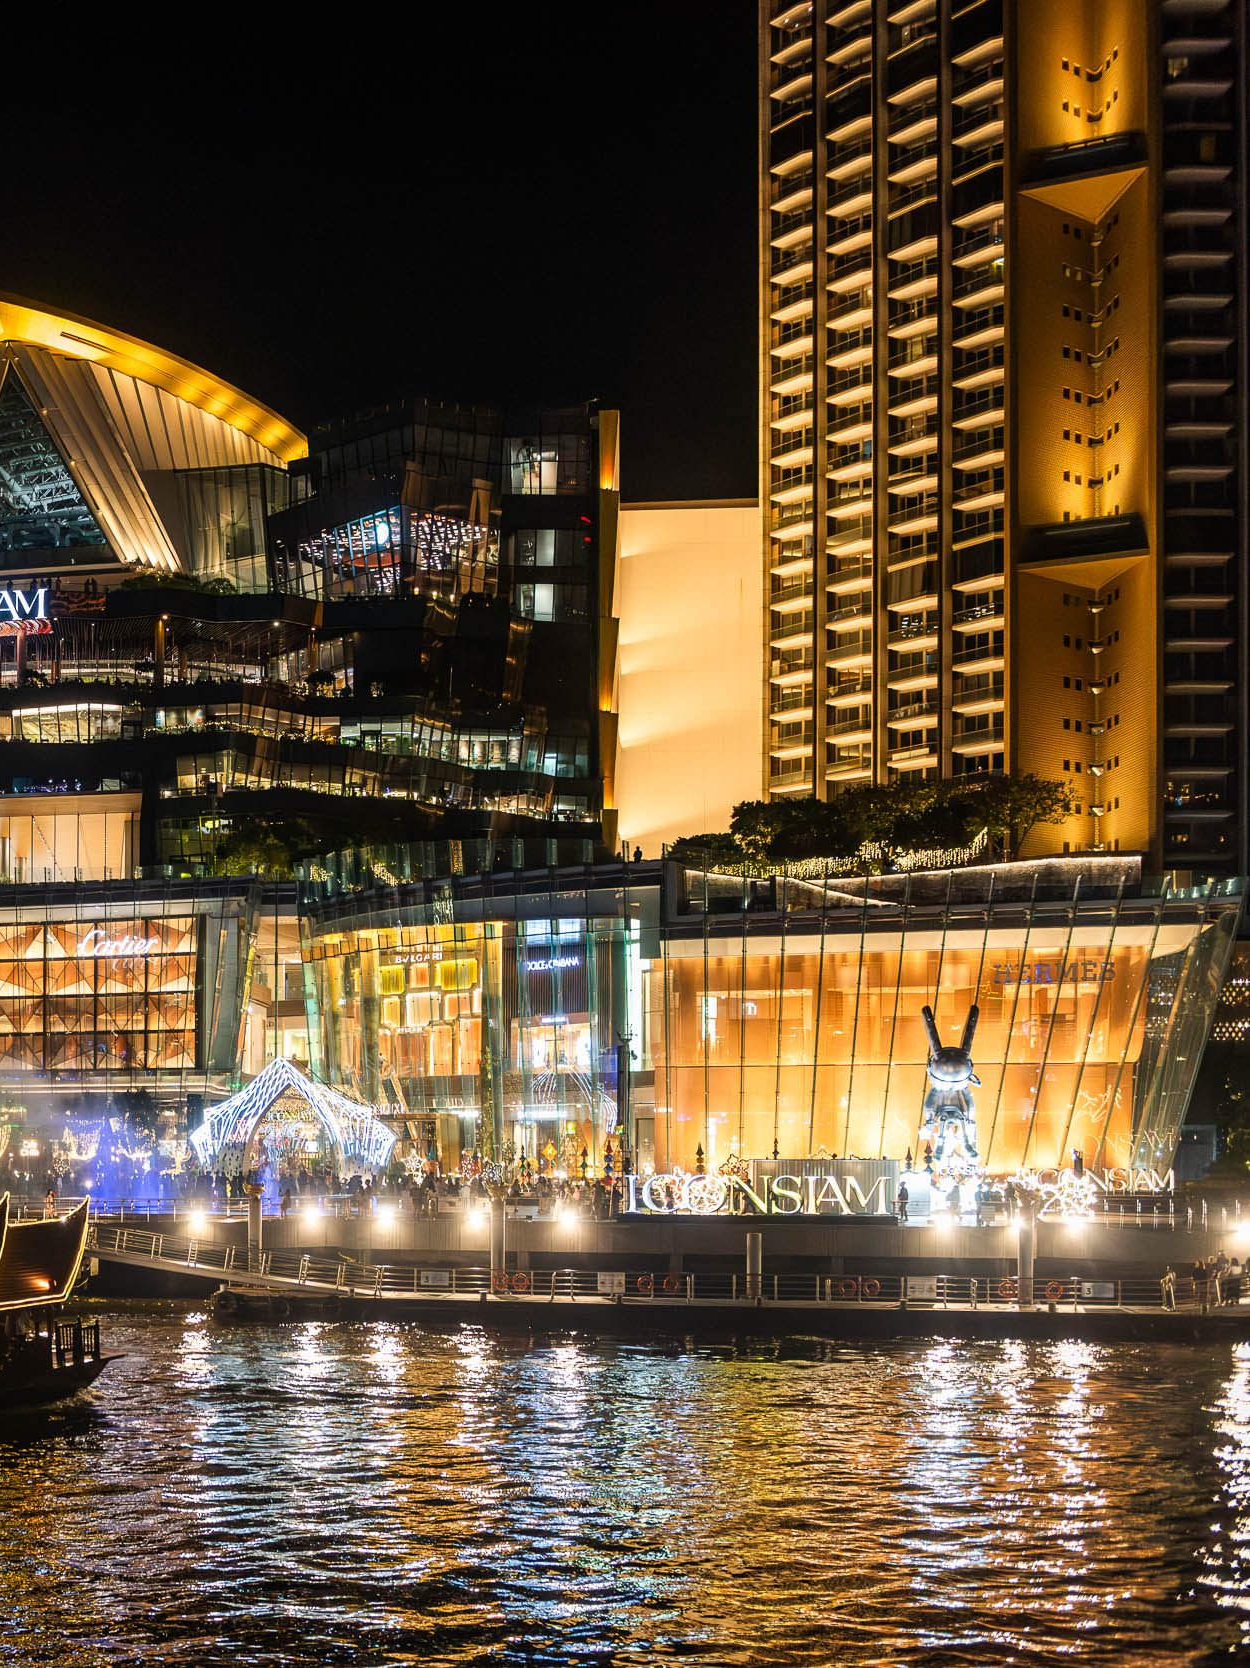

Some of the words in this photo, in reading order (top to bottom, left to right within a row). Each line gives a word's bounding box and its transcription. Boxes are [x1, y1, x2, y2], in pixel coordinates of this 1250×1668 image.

[77, 929, 159, 957] Cartier
[624, 1173, 892, 1216] ICONSIAM
[1085, 1287, 1092, 1296] 3
